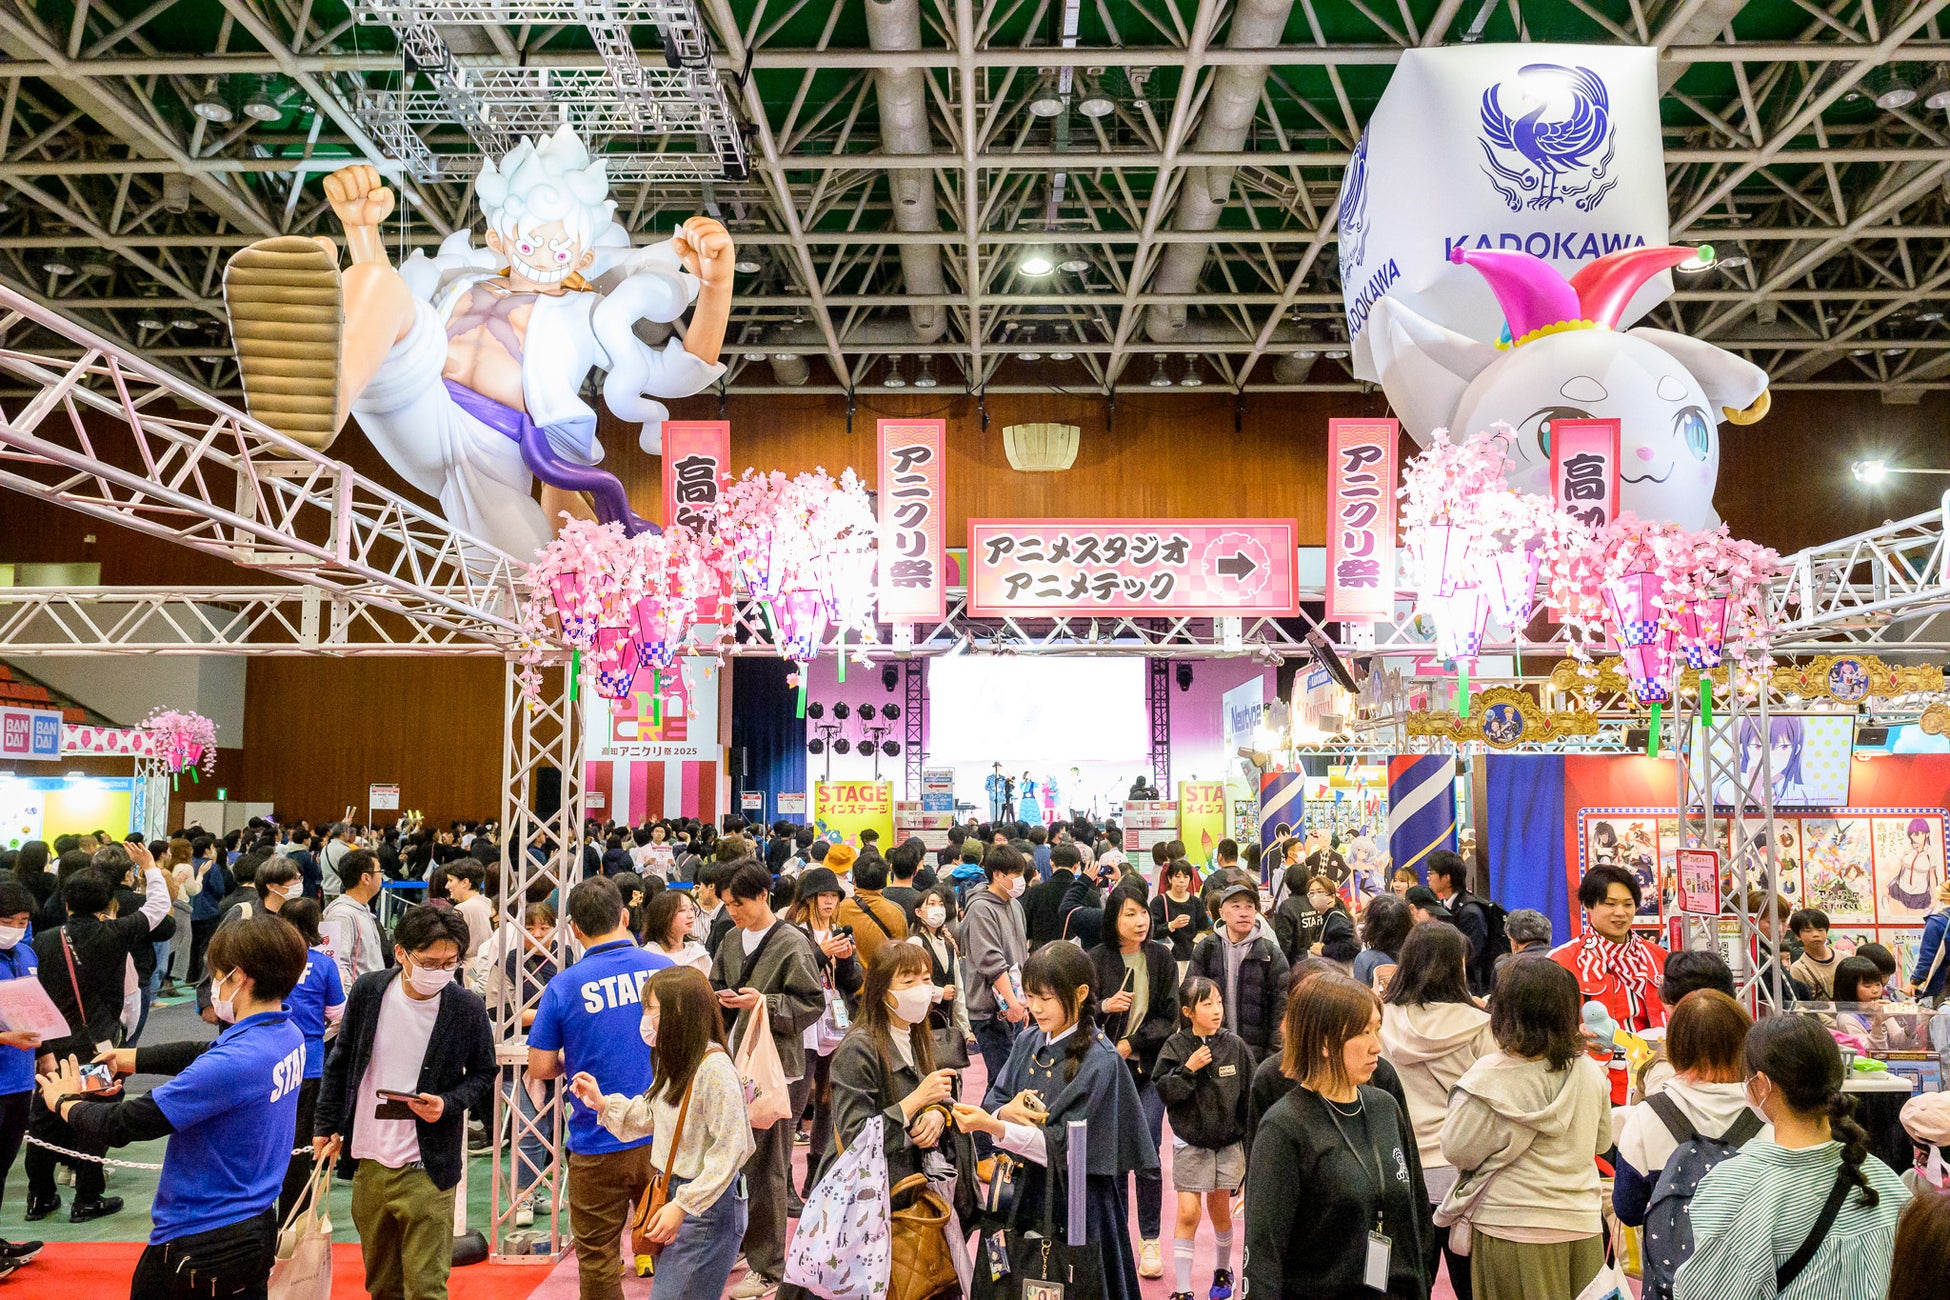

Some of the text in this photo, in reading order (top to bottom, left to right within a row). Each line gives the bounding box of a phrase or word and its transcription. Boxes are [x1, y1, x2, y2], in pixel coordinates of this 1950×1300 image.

[891, 446, 933, 589] アニクリ祭
[1337, 445, 1383, 588] アニクリ祭
[985, 536, 1190, 565] アニメスタジオ
[1004, 572, 1175, 601] アニメテック
[5, 719, 29, 733] BAN
[36, 721, 58, 735] BAN
[5, 733, 25, 747] DAI
[35, 735, 53, 749] DAI
[818, 785, 888, 802] STAGE
[819, 805, 888, 814] メインステージ
[580, 969, 661, 1014] STAF
